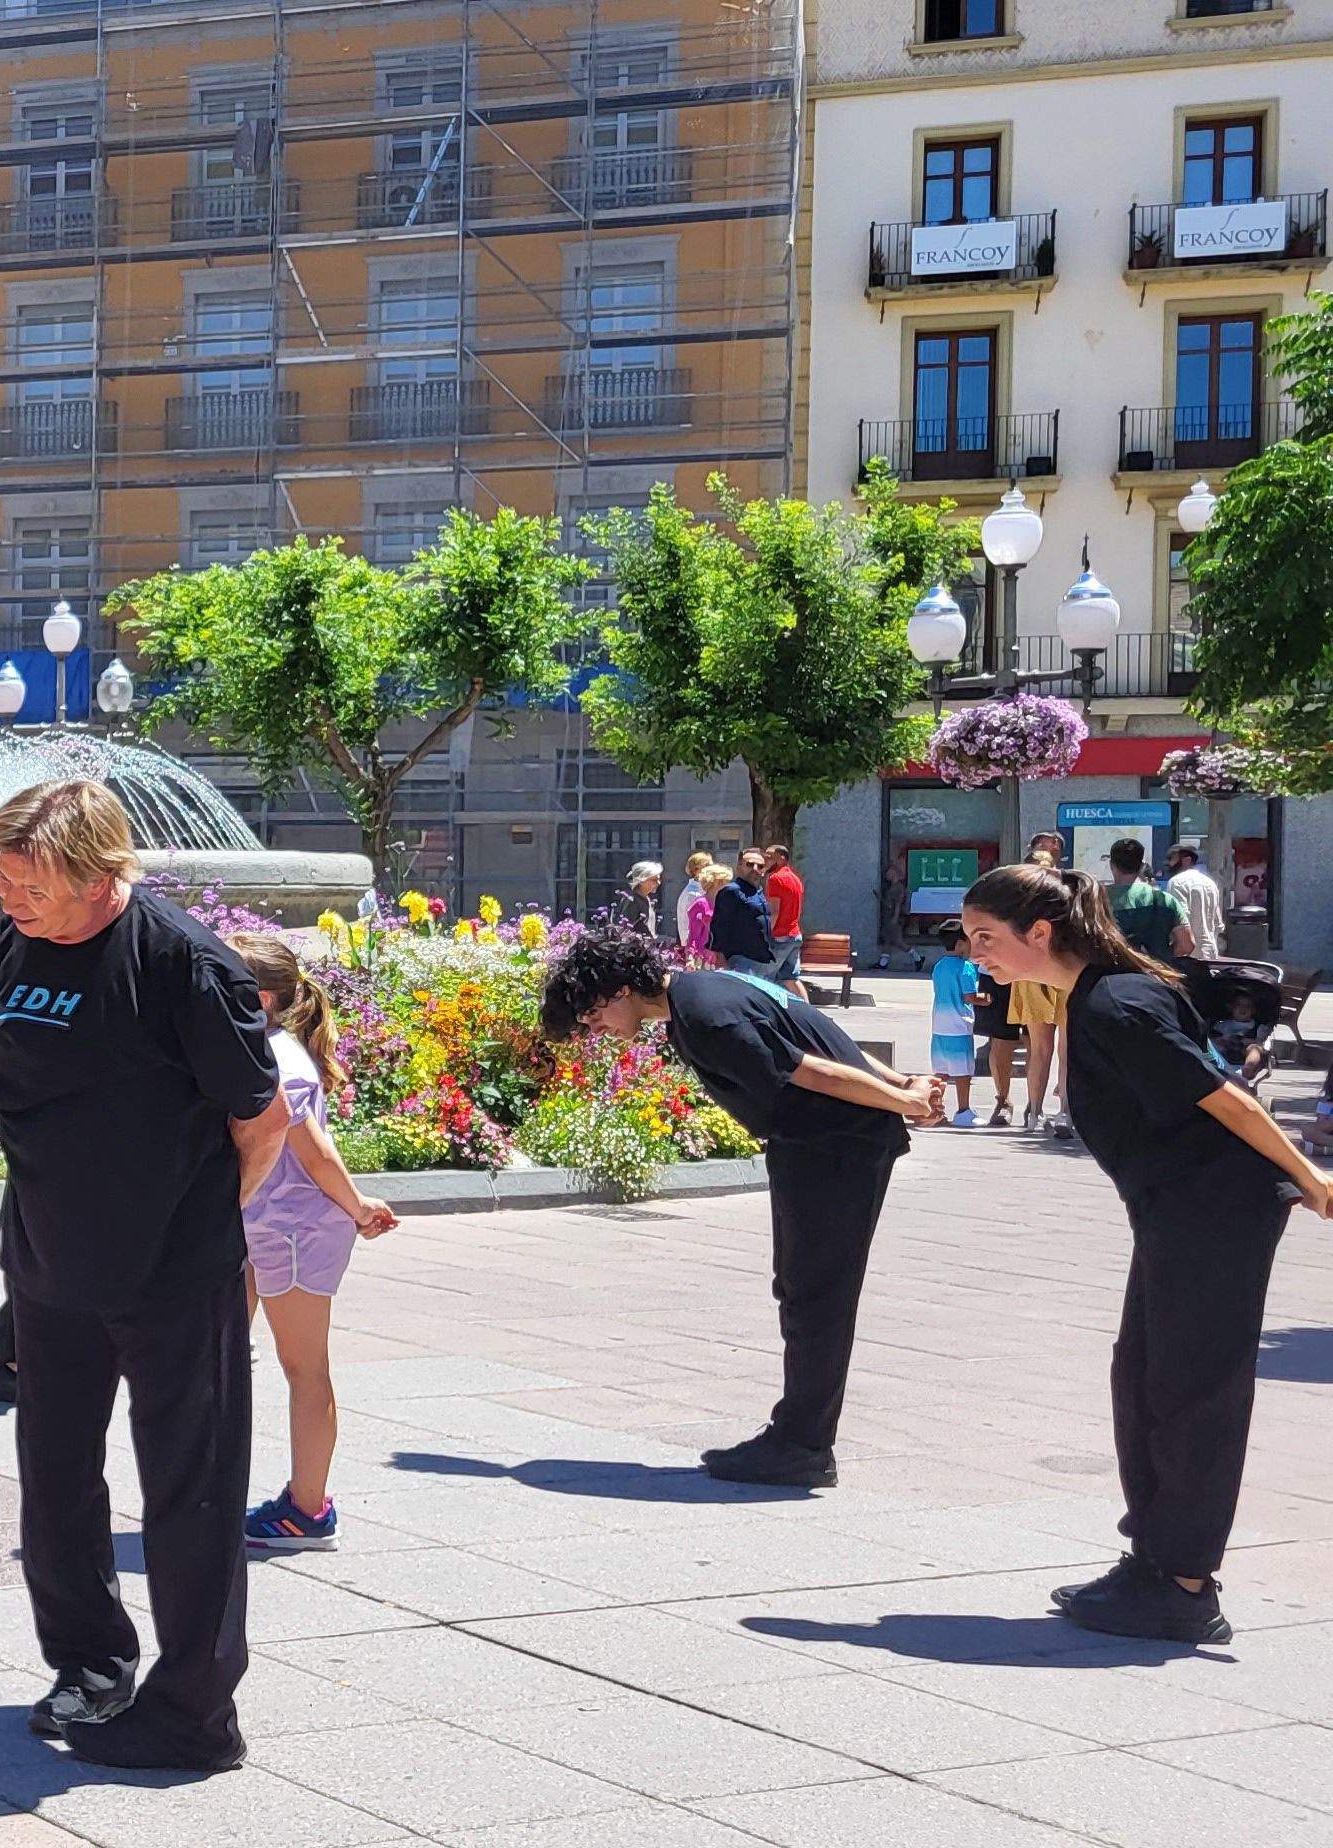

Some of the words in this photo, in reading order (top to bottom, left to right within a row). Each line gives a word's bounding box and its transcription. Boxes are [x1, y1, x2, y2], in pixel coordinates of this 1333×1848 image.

[1179, 227, 1279, 248] FRANCOY
[916, 245, 1011, 266] FRANCOY
[1065, 808, 1113, 819] HUESCA
[5, 984, 85, 1016] EDH
